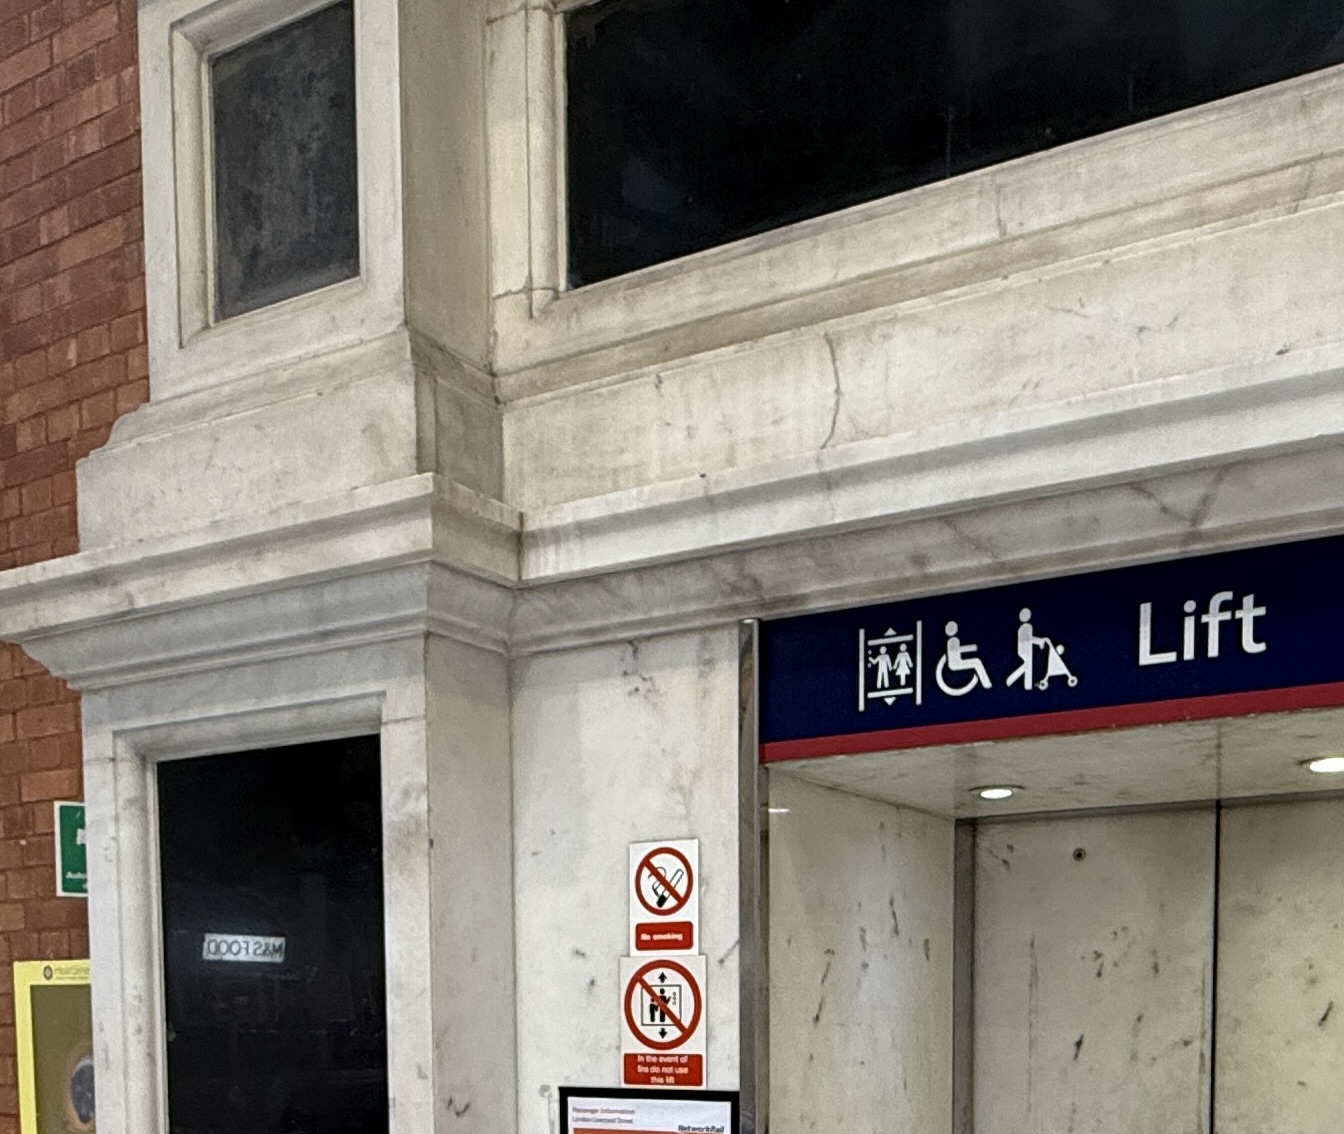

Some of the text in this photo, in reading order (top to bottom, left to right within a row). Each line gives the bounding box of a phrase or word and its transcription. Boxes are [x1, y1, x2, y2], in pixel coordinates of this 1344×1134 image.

[1138, 591, 1267, 666] Lift
[641, 932, 683, 942] No smoking
[638, 1055, 643, 1063] In
[645, 1055, 657, 1063] the
[679, 1055, 688, 1063] of
[662, 1066, 673, 1074] not
